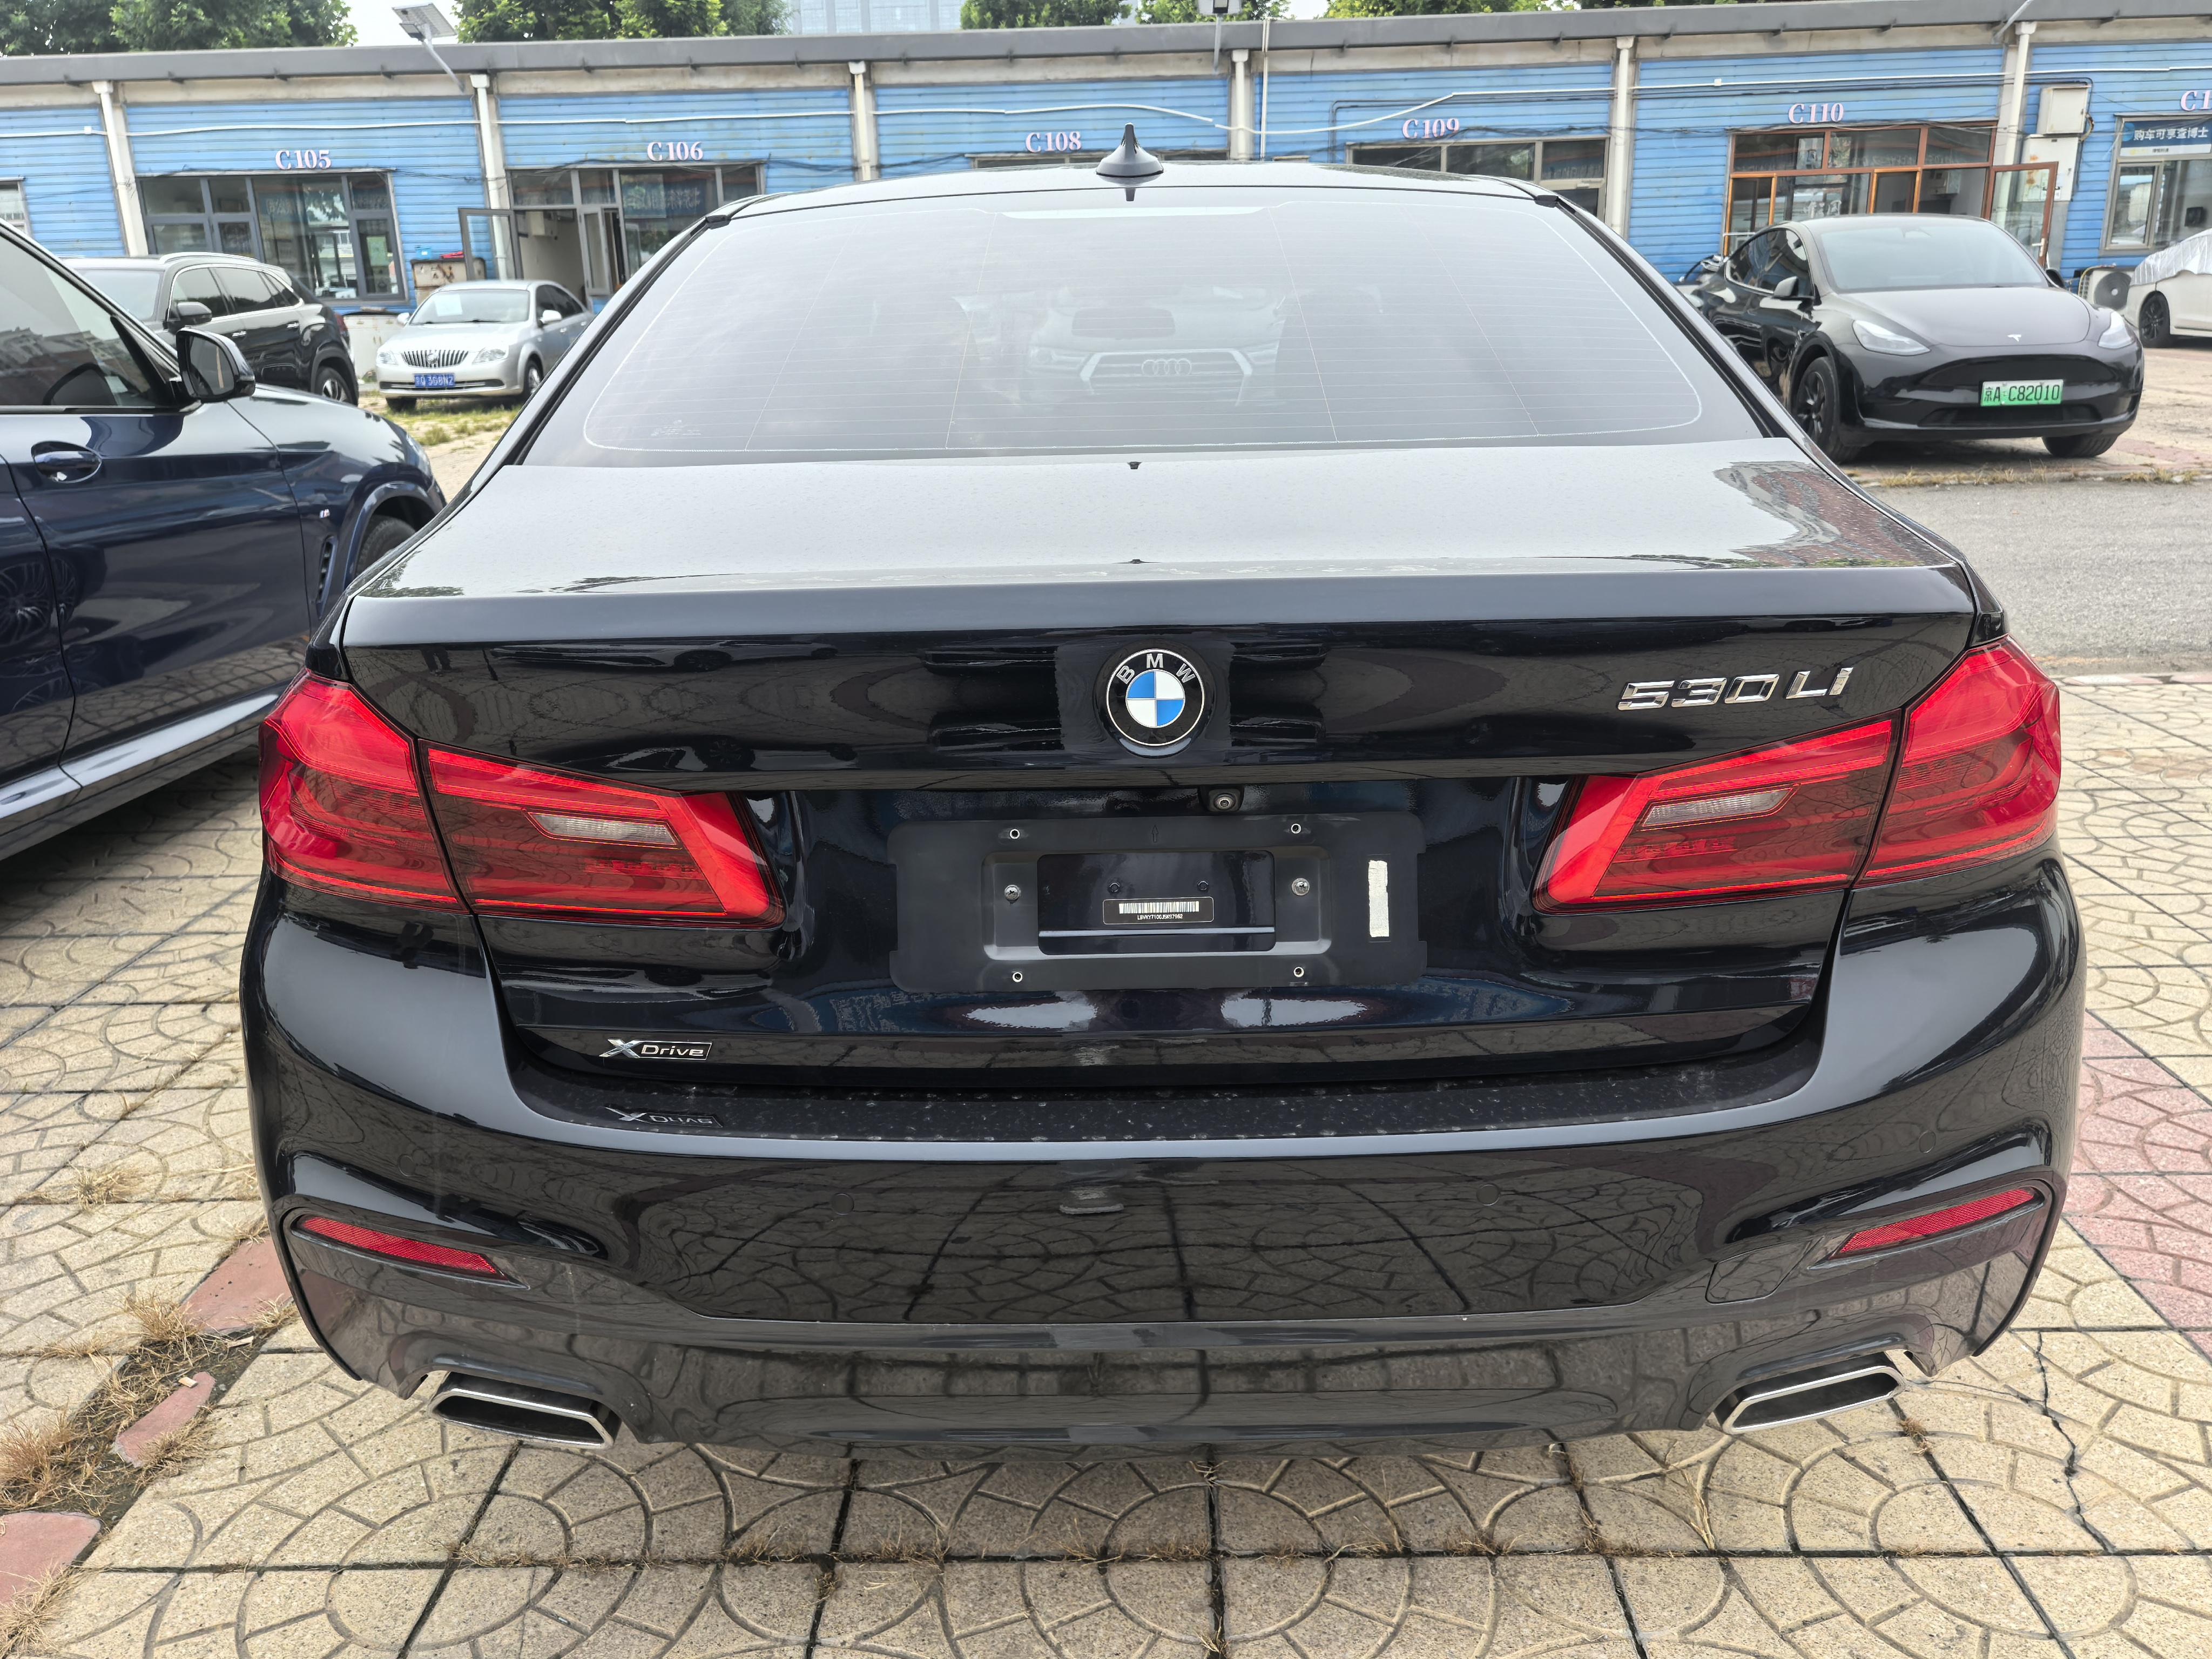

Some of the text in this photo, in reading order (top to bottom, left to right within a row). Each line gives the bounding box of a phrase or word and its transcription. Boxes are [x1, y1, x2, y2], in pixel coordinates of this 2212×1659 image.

[1788, 103, 1844, 124] C110
[1402, 118, 1459, 139] C109
[2134, 126, 2209, 140] 购车可享查博士
[647, 141, 703, 161] C106
[1026, 131, 1081, 152] C108
[275, 150, 331, 170] C105
[1116, 653, 1196, 684] BMW
